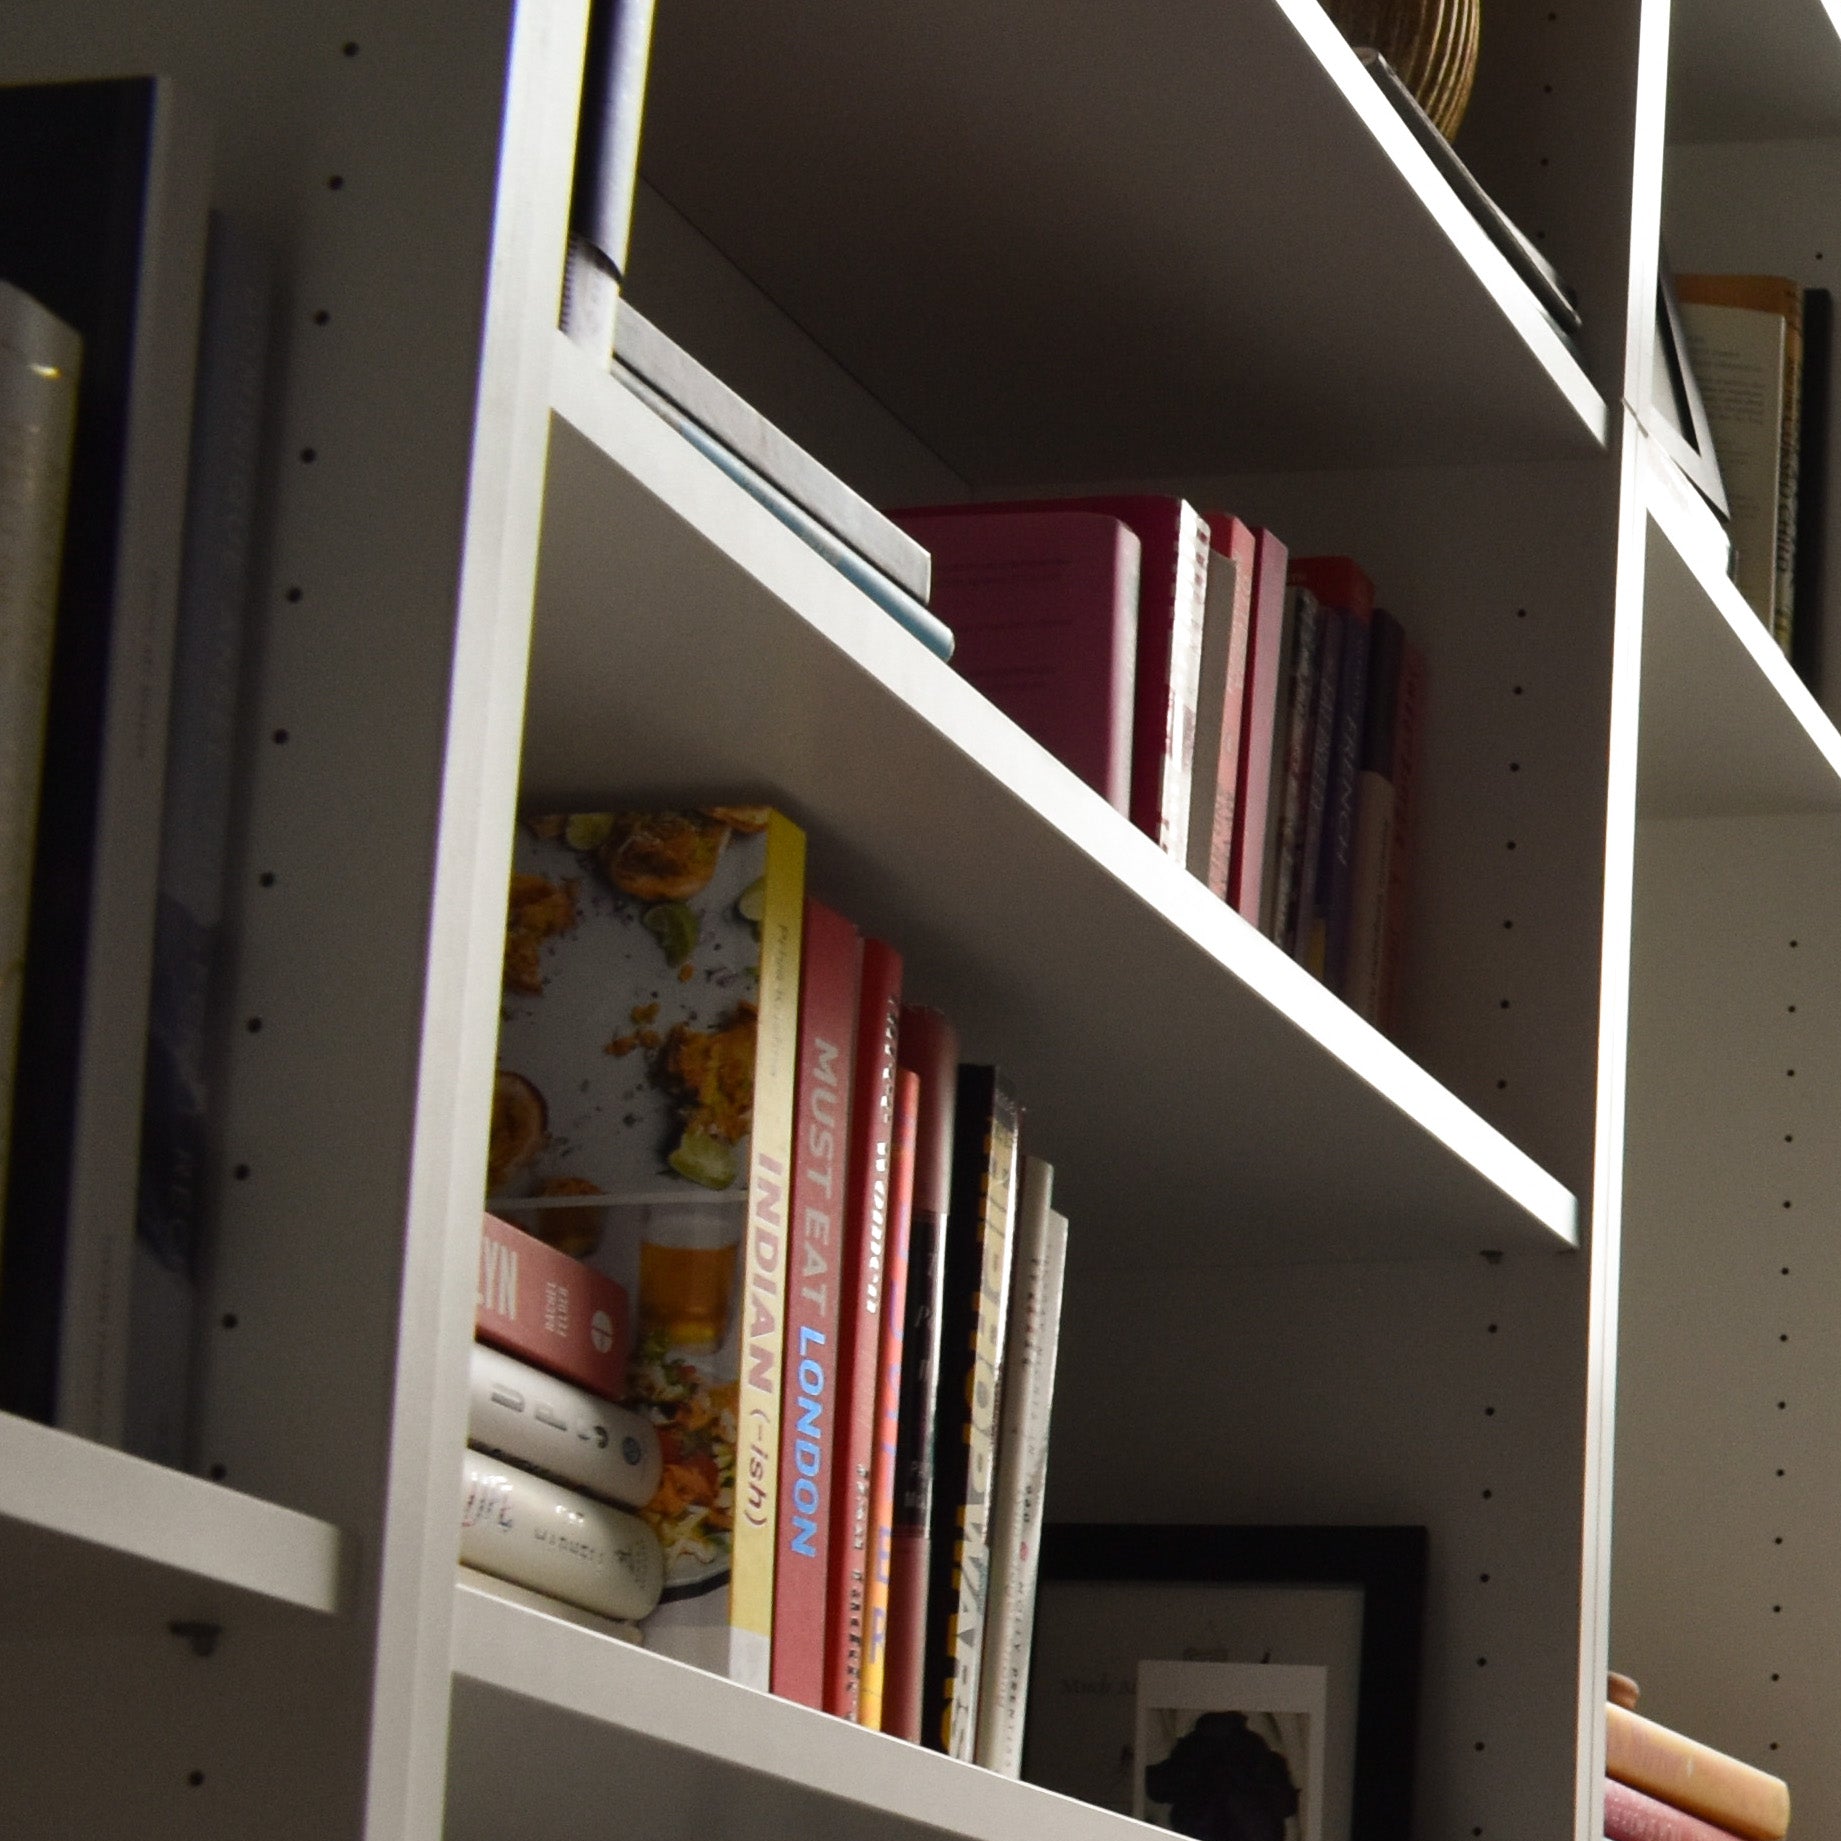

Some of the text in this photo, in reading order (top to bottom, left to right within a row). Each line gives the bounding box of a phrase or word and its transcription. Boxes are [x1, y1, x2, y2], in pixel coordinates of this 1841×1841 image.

[743, 1152, 783, 1527] INDIAN (-ish)
[791, 1037, 840, 1557] MUST EAT LONDON
[963, 1291, 1007, 1496] HOP
